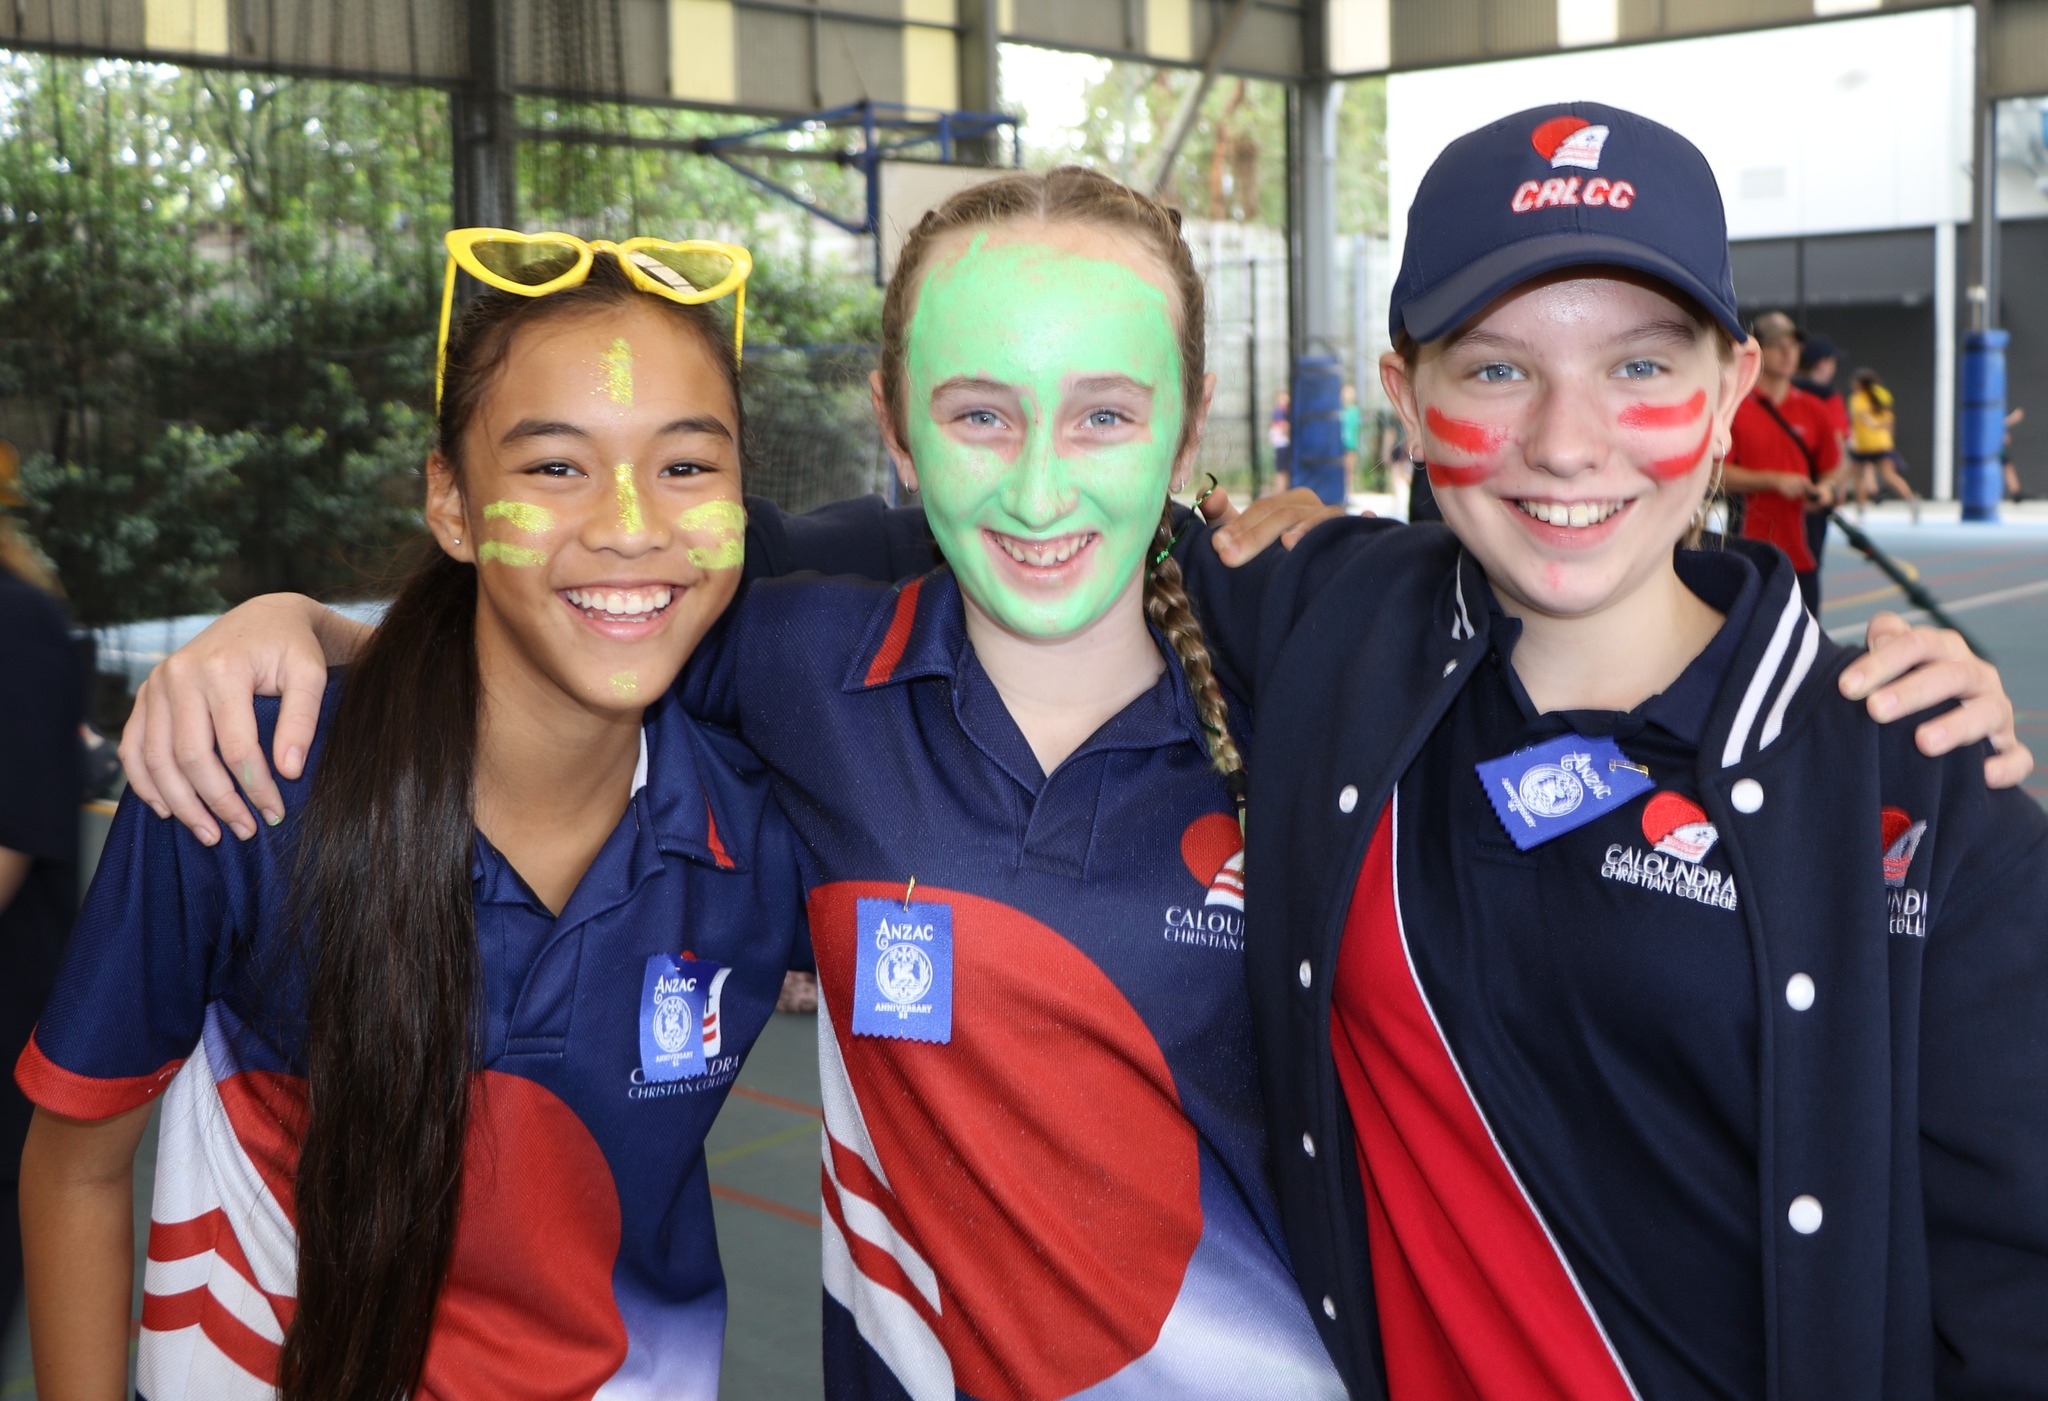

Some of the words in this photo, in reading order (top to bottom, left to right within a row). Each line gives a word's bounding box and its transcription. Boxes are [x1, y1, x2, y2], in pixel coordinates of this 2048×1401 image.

[1560, 751, 1611, 799] ANZAC
[1601, 861, 1673, 895] CHRISTIAN
[1676, 879, 1738, 911] COLLEGE
[1605, 844, 1737, 897] CALOUNDRA
[875, 917, 934, 950] ANZAC
[1165, 905, 1245, 937] CALOU
[1164, 927, 1238, 951] CHRISTIAN
[654, 975, 697, 1004] ANZAC
[628, 1083, 693, 1099] CHRISTIAN
